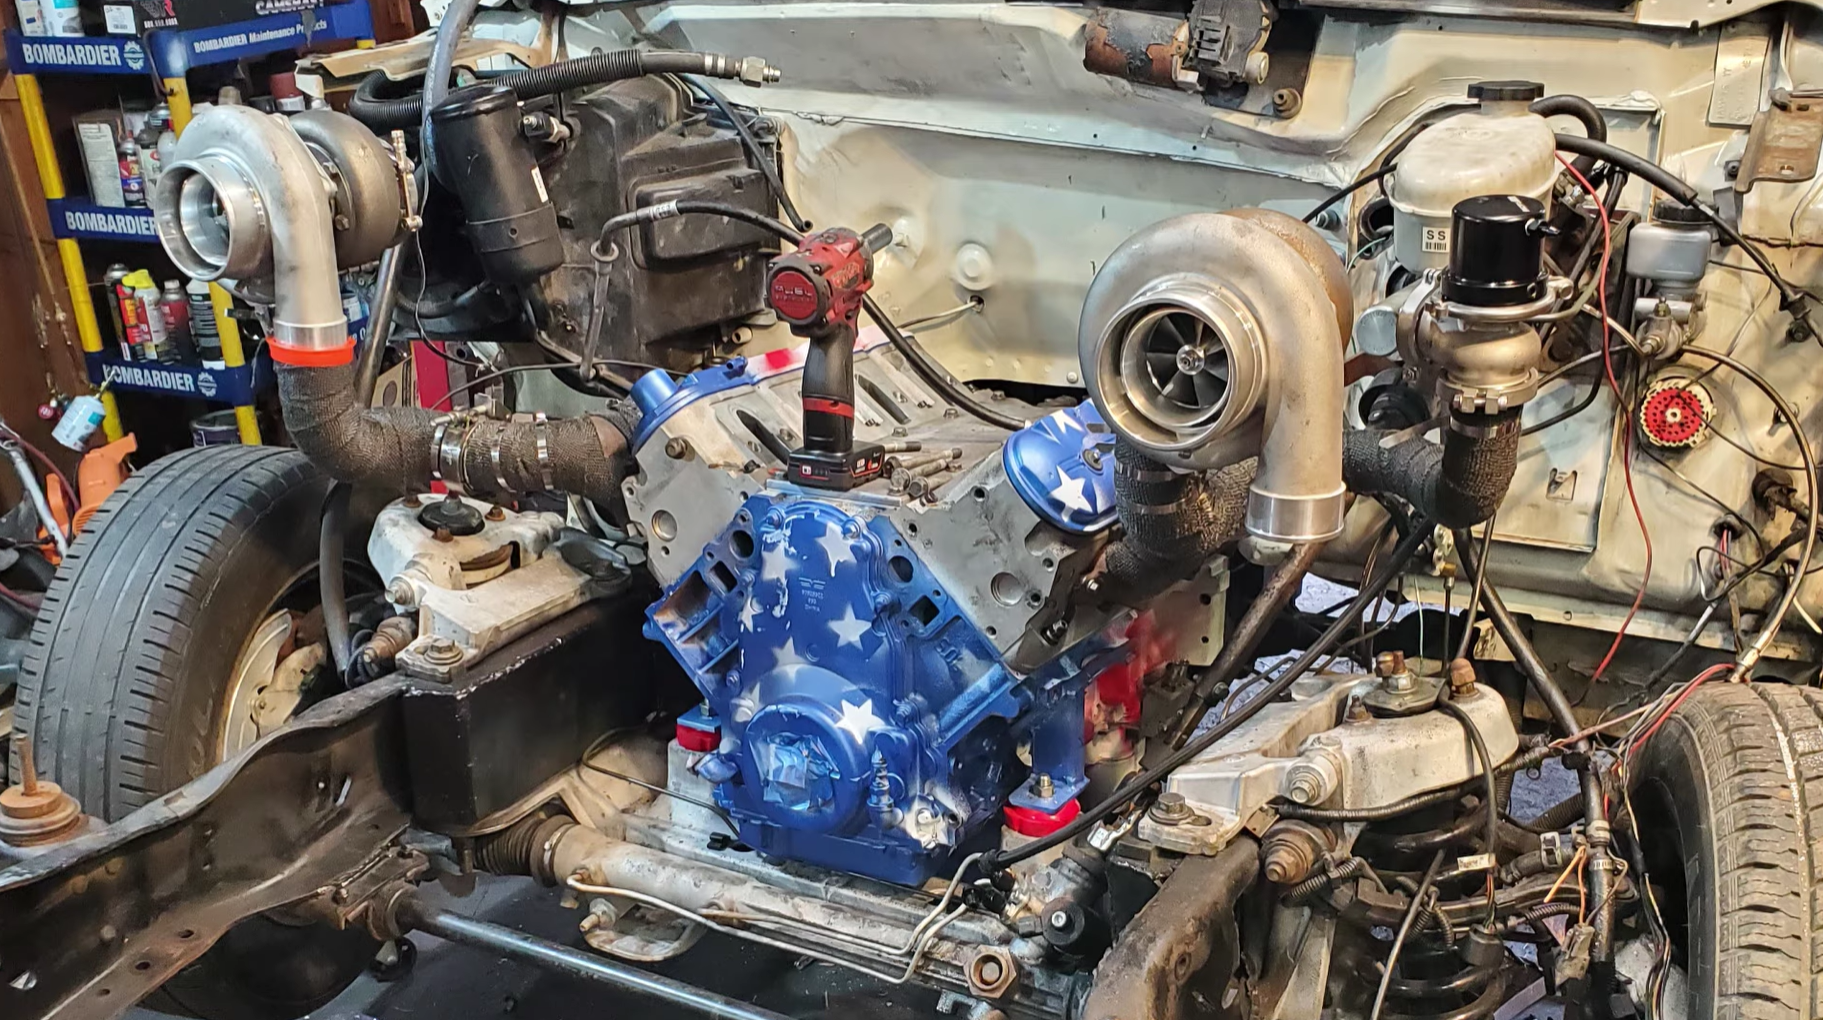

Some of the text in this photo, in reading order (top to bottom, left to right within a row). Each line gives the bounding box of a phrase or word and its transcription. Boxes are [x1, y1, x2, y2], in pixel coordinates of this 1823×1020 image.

[193, 19, 328, 53] BOMBARDIER Maintenance Prcts
[22, 43, 122, 66] BOMBARDIER
[65, 211, 158, 236] BOMBARDIER
